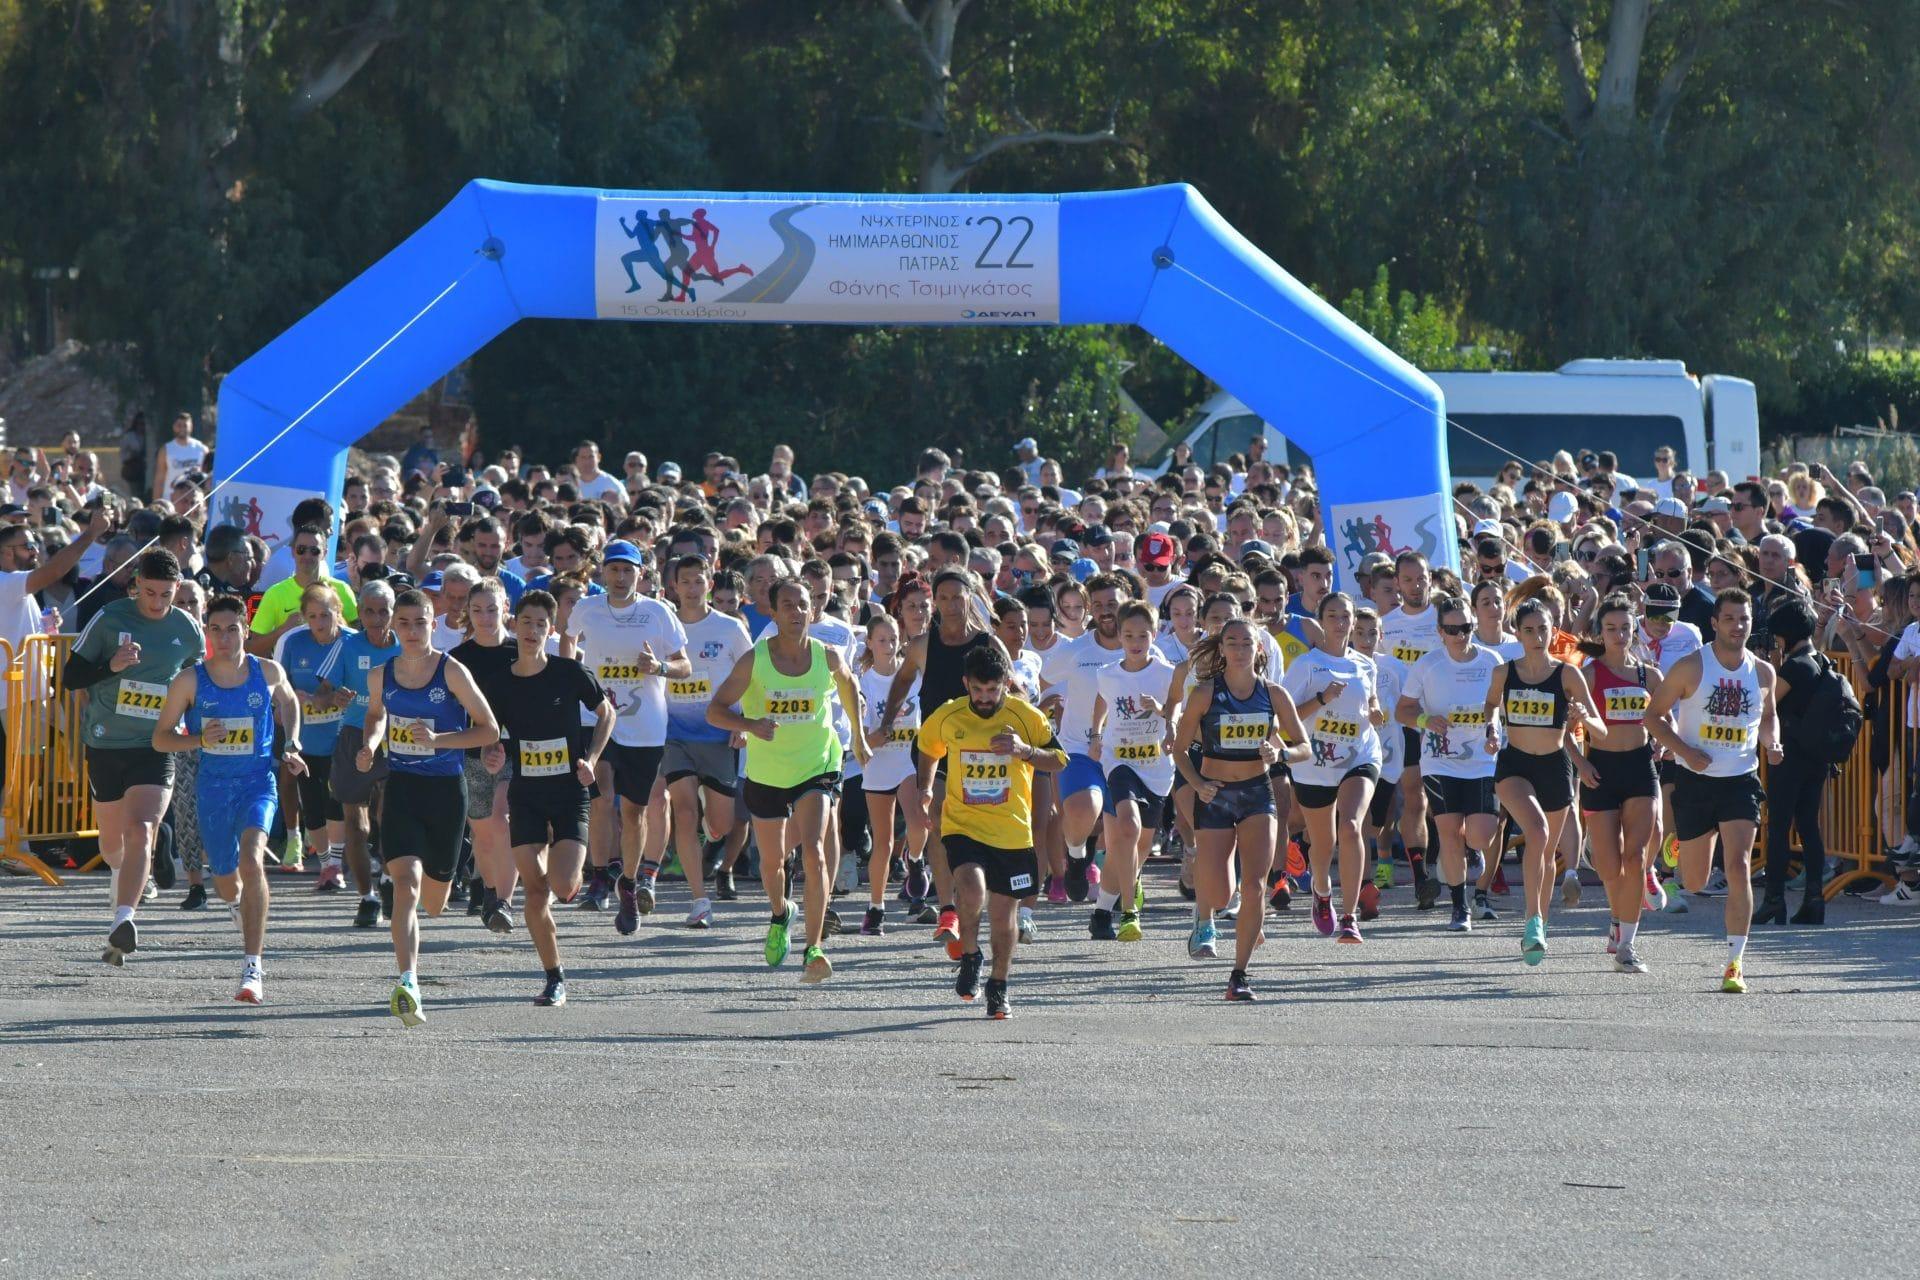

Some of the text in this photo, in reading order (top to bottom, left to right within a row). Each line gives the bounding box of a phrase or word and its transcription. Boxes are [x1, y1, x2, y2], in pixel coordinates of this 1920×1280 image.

[861, 215, 960, 228] ΝΥΧΤΕΡΙΝΟΣ
[829, 234, 960, 249] ΗΜΙΜΑΡΑΘΩΝΙΟΣ
[899, 256, 960, 271] ΠΑΤΡΑΣ
[829, 280, 1033, 299] Φάνης Τσιμιγκάτος
[622, 304, 747, 318] 15 Οκτωβρίου
[602, 665, 639, 679] 2239
[672, 681, 707, 694] 2124
[122, 691, 162, 709] 2272
[770, 700, 810, 714] 2203
[1511, 700, 1550, 715] 2139
[1611, 697, 1646, 711] 2162
[1225, 724, 1265, 739] 2098
[1319, 719, 1357, 736] 2265
[1706, 725, 1742, 742] 1901
[524, 750, 564, 767] 2199
[1119, 745, 1156, 759] 2842
[966, 764, 1008, 779] 2920
